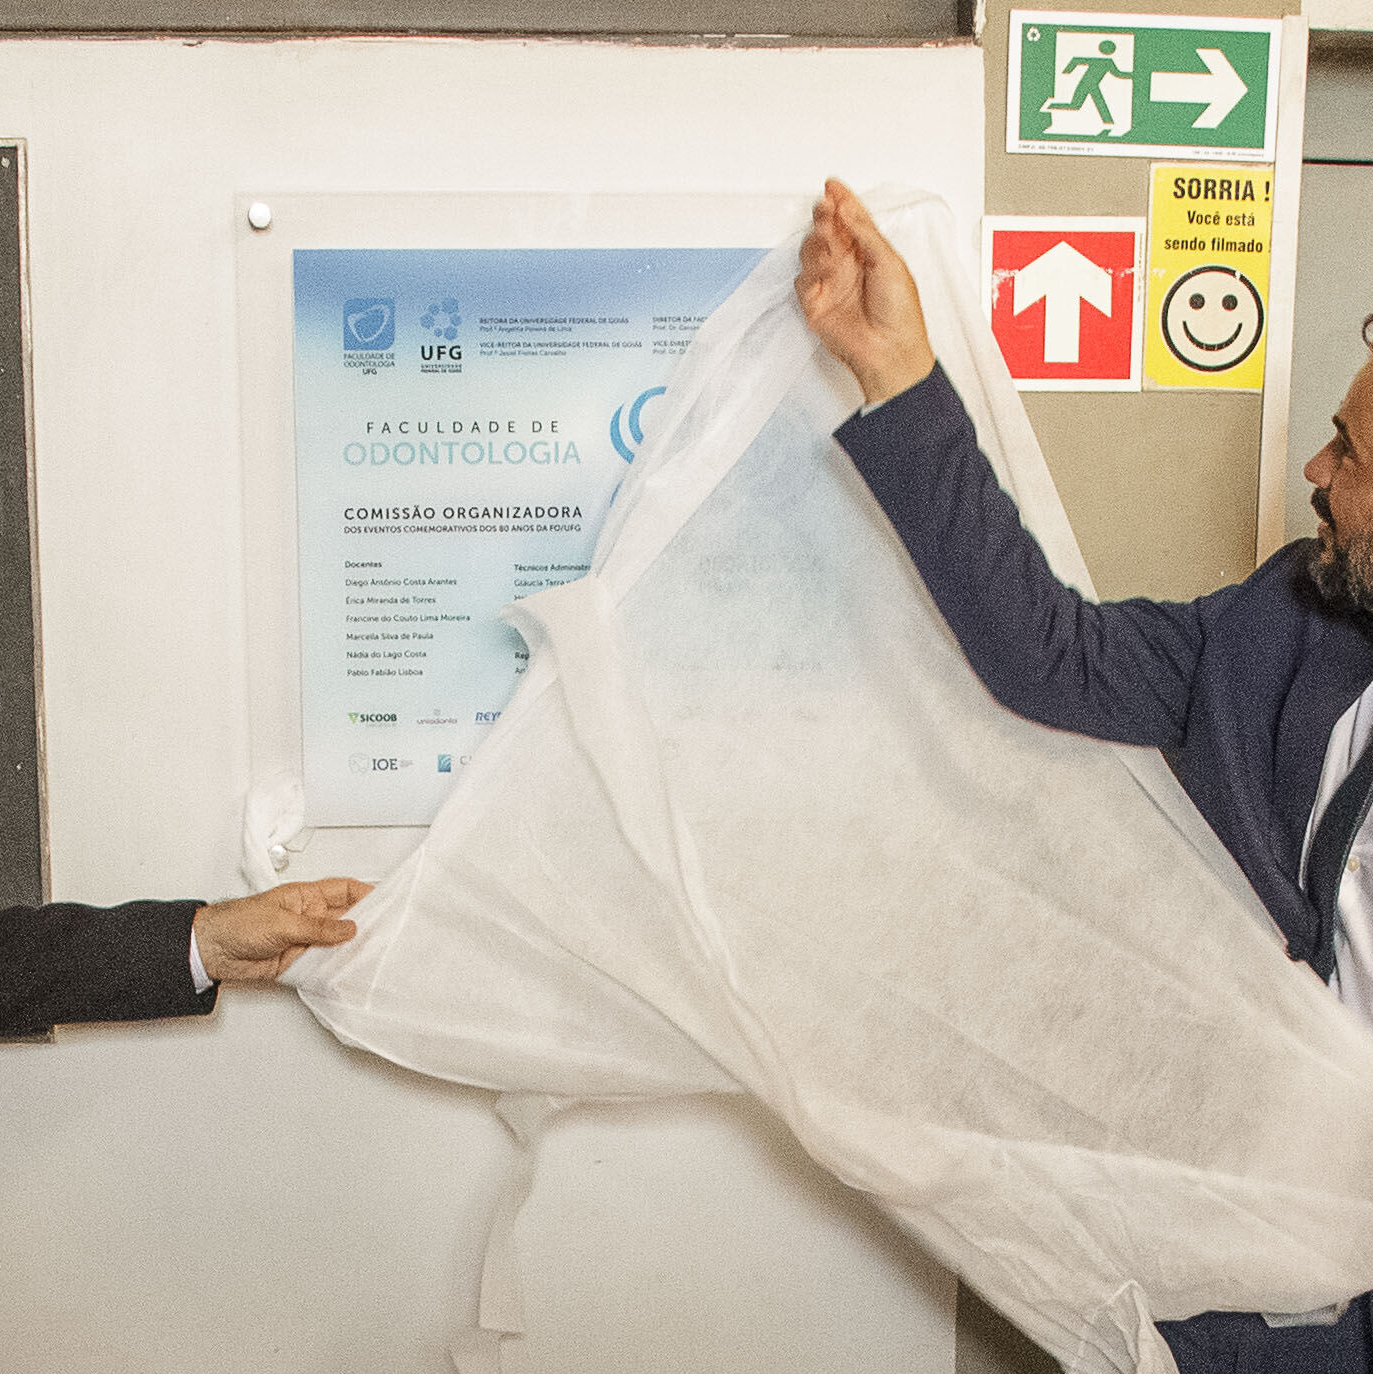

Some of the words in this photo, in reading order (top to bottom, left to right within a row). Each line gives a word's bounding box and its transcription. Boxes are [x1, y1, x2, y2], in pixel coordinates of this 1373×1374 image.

[1172, 177, 1255, 201] SORRIA
[1187, 210, 1220, 225] Você
[1225, 211, 1255, 226] está
[1164, 237, 1206, 251] sendo
[1211, 236, 1263, 253] filmado
[421, 345, 462, 360] UFG
[366, 421, 515, 434] FACULDADE
[532, 421, 559, 433] DE
[343, 440, 582, 466] ODONTOLOGIA
[344, 504, 436, 521] COMISSÃO
[442, 505, 583, 520] ORGANIZADORA
[344, 525, 362, 534] DOS
[364, 525, 402, 534] EVENTOS
[403, 525, 478, 533] COMEMORATIVOS
[479, 525, 497, 533] DOS
[499, 525, 509, 533] 80
[511, 524, 534, 533] ANOS
[549, 524, 582, 533] FO/UFG
[345, 579, 368, 587] Diego
[381, 614, 392, 622] do
[400, 632, 411, 640] de
[371, 650, 381, 658] do
[404, 650, 427, 658] Costa
[360, 713, 398, 723] SICOOB
[372, 758, 398, 771] IOE
